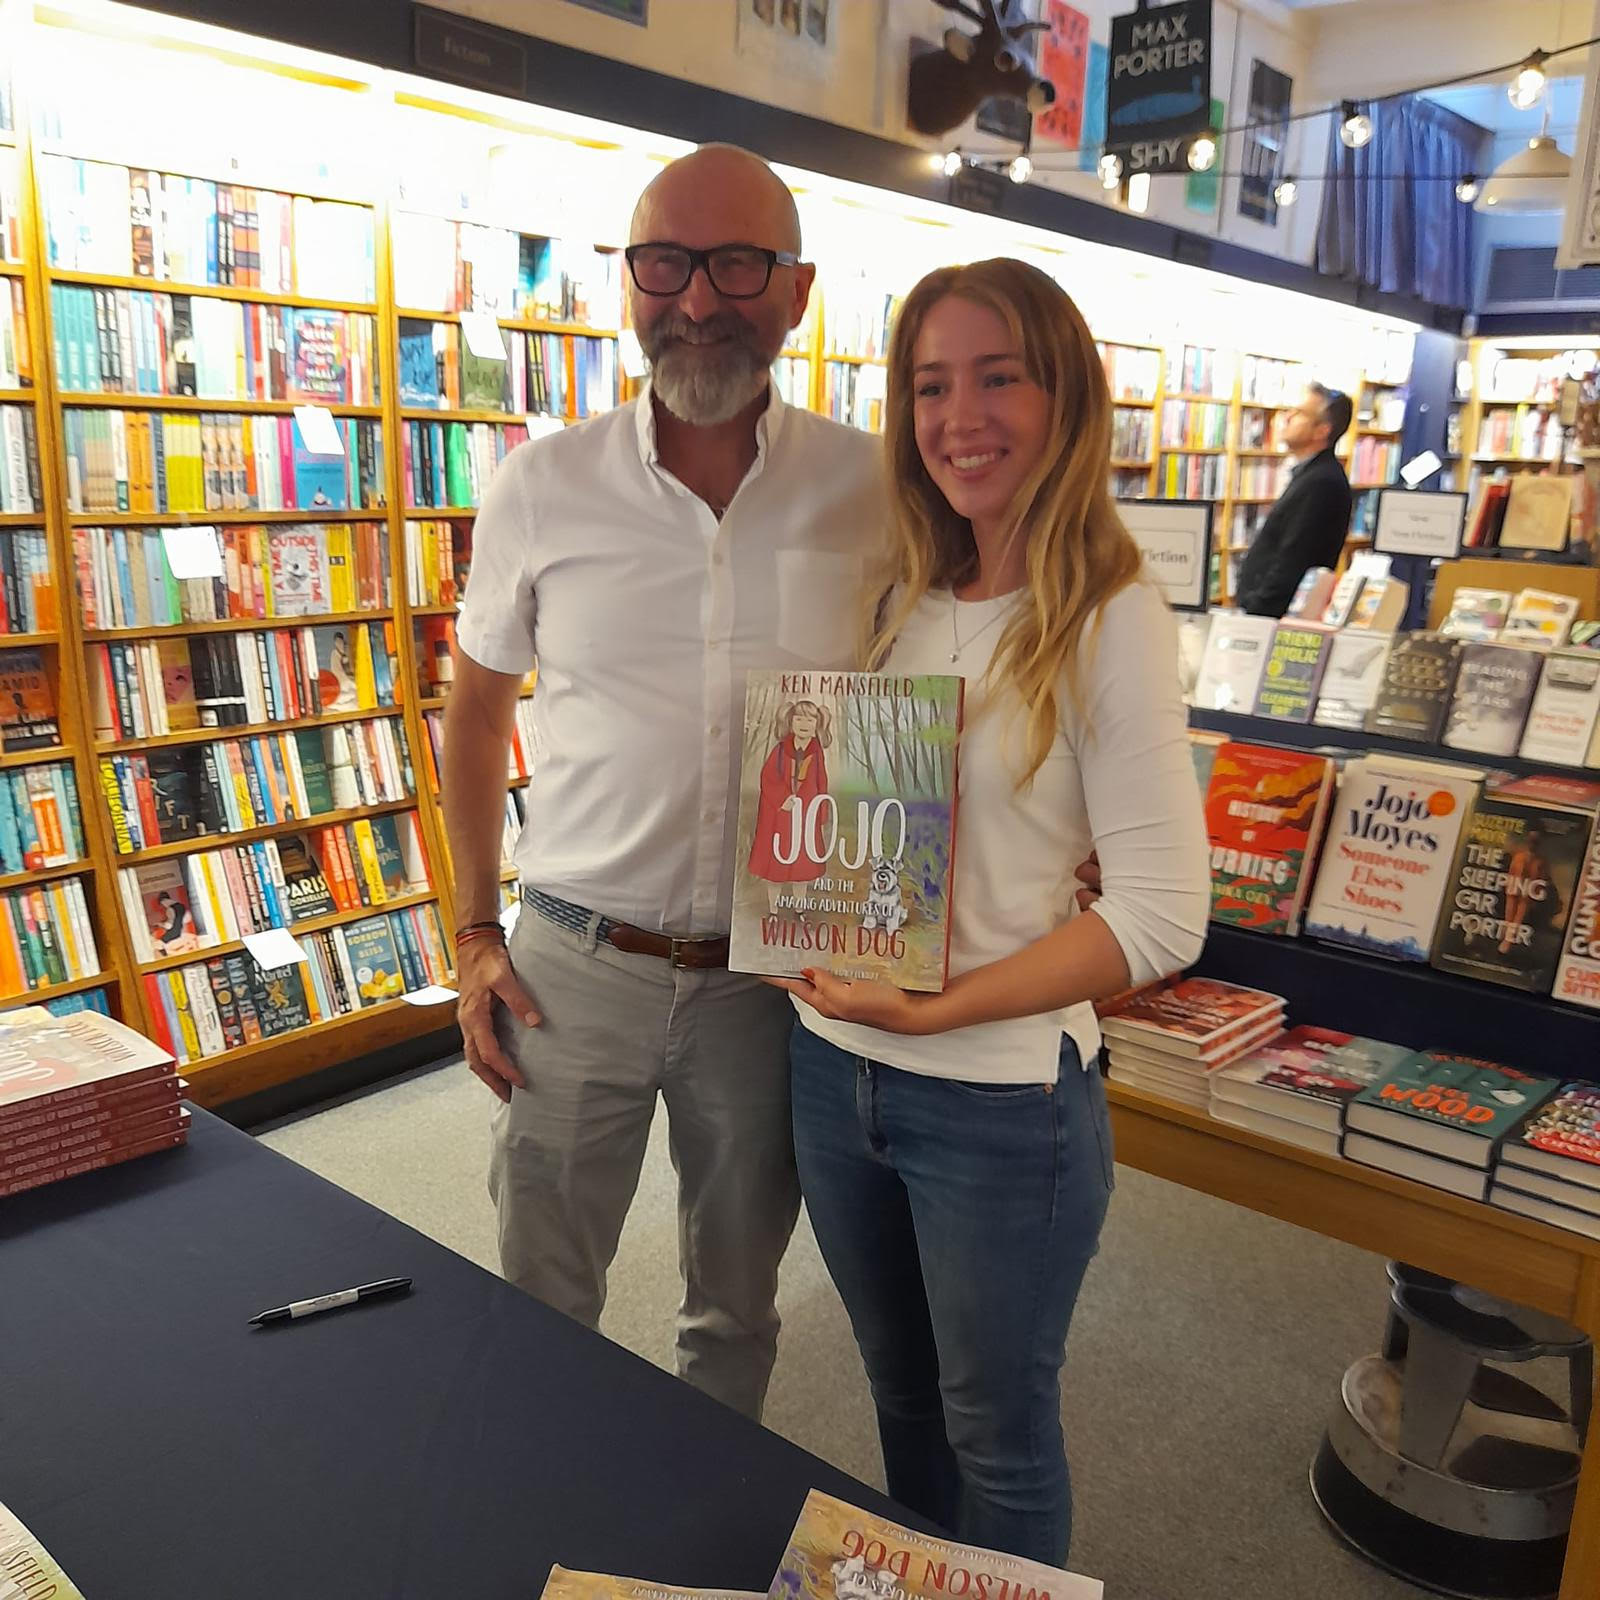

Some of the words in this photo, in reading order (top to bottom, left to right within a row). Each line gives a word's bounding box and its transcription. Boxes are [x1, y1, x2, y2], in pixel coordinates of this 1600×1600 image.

[1132, 13, 1187, 48] MAX
[1114, 37, 1205, 80] PORTER
[1129, 136, 1183, 169] SHY
[781, 674, 811, 694] KEN
[819, 674, 914, 698] MANSFIELD
[1365, 784, 1432, 823] Jojo
[773, 794, 907, 870] JOJO
[1345, 809, 1438, 852] Moyes
[1340, 843, 1430, 876] Someone
[1466, 843, 1506, 869] THE
[814, 878, 835, 891] AND
[837, 880, 855, 893] THE
[1343, 884, 1402, 913] Shoes
[1460, 866, 1547, 901] SLEEPING
[774, 895, 817, 910] AMAZING
[818, 898, 880, 915] ADVENTURES
[881, 901, 895, 915] OF
[1455, 888, 1499, 915] CAR
[761, 916, 848, 954] WILSON
[857, 928, 906, 959] DOG
[1450, 911, 1535, 946] PORTER
[1379, 1083, 1495, 1123] WOOD
[841, 1530, 911, 1579] DOG
